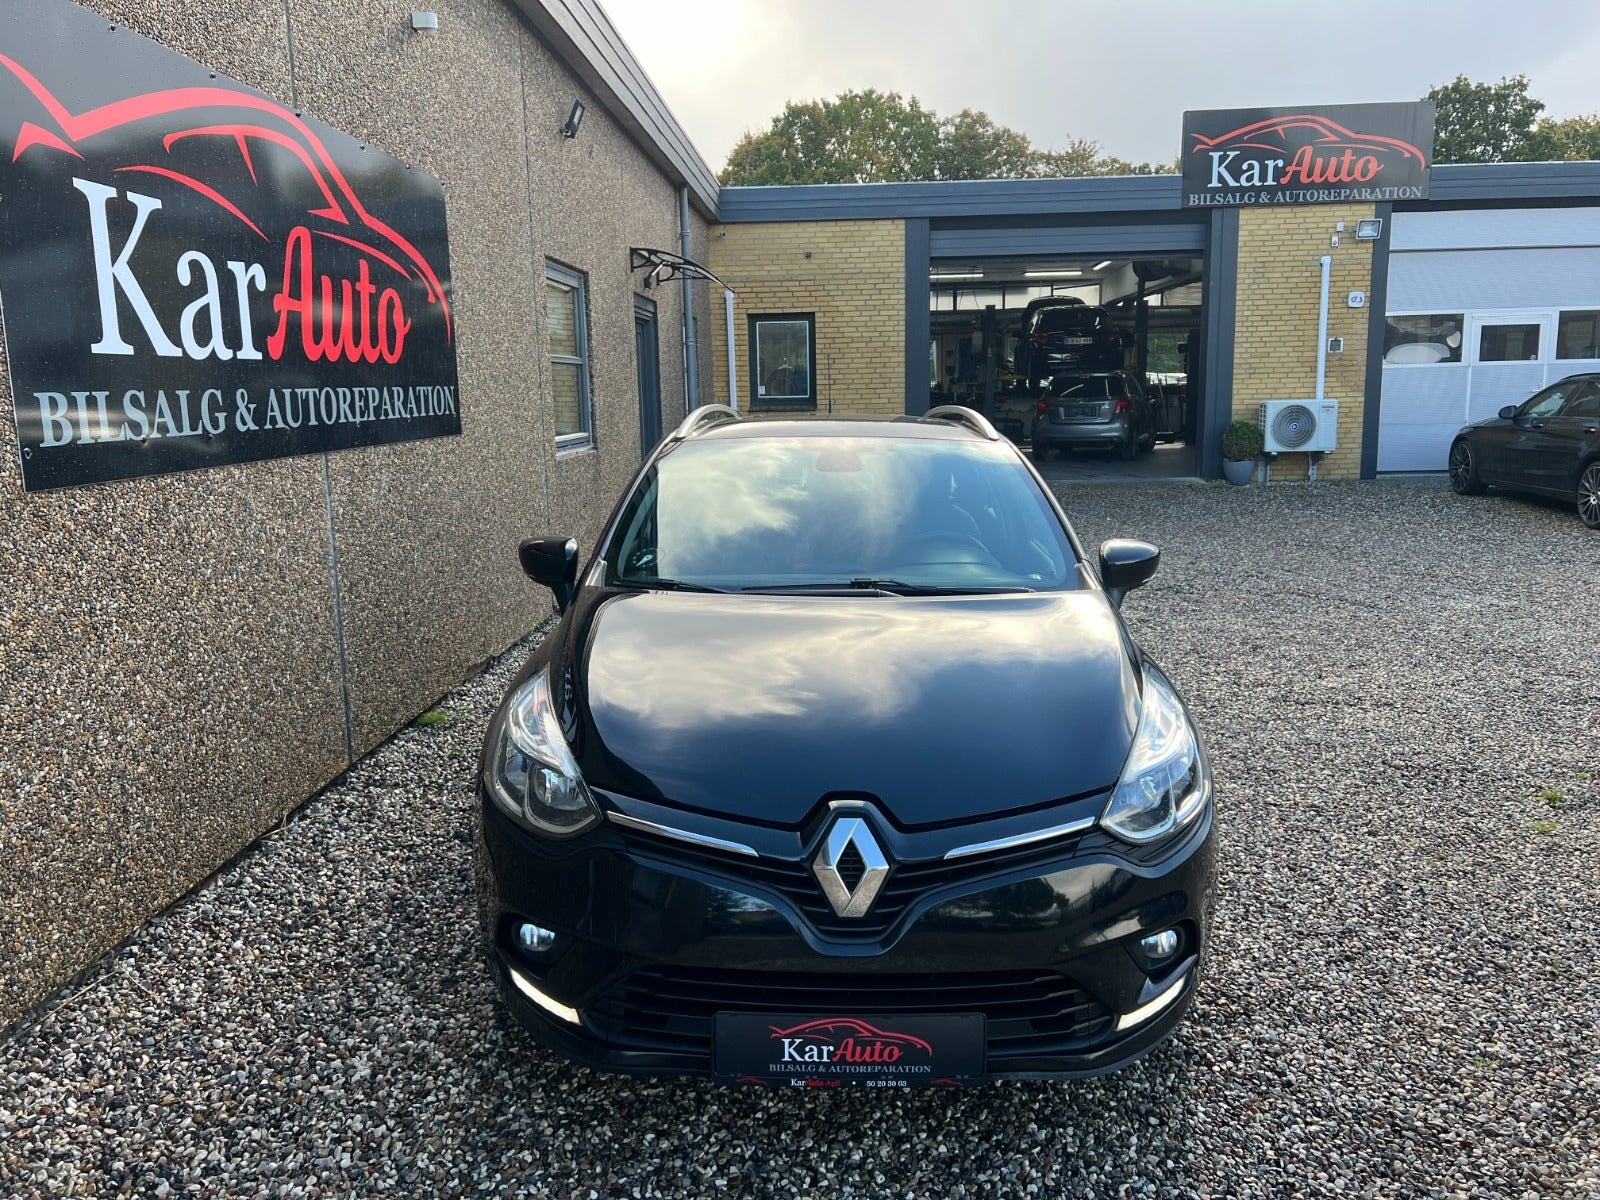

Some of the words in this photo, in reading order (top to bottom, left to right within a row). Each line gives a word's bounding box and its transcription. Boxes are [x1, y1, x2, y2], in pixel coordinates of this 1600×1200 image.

[1207, 145, 1384, 188] KarAuto
[1189, 192, 1256, 206] BILSALG
[1259, 192, 1271, 203] &
[1276, 186, 1423, 202] AUTOREPARATION
[73, 177, 411, 364] KarAuto
[33, 388, 227, 447] BILSALG
[235, 389, 259, 432] &
[264, 385, 457, 428] AUTOREPARATION
[781, 1037, 903, 1062] KarAuto
[769, 1064, 816, 1072] BILSALG
[818, 1065, 827, 1073] &
[830, 1065, 932, 1073] AUTOREPARATION
